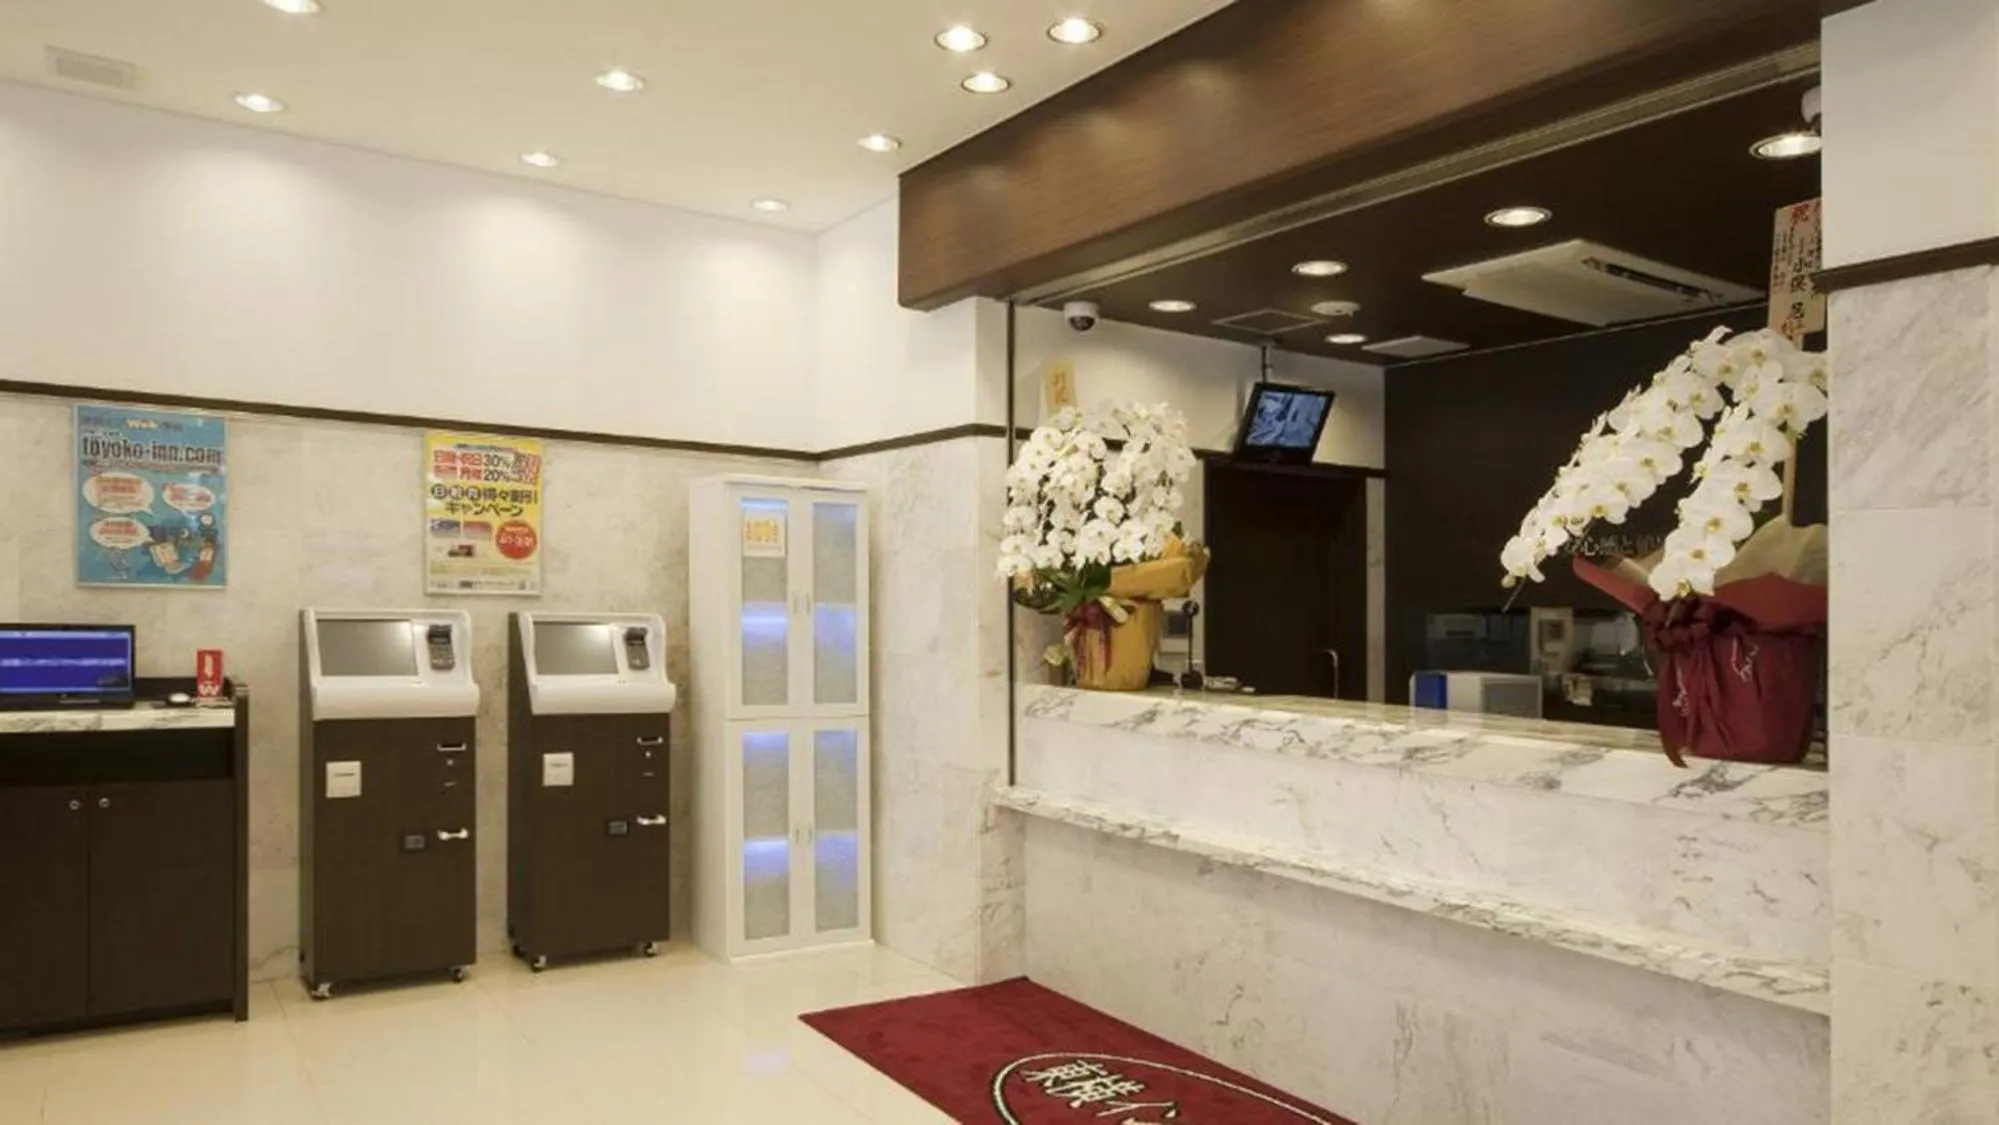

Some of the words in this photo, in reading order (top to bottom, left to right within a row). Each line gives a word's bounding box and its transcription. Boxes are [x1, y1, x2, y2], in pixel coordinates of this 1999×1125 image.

[82, 435, 222, 464] toyoko-inn.com
[445, 500, 523, 516] キャンペーン
[1021, 1059, 1176, 1125] 東横イ
